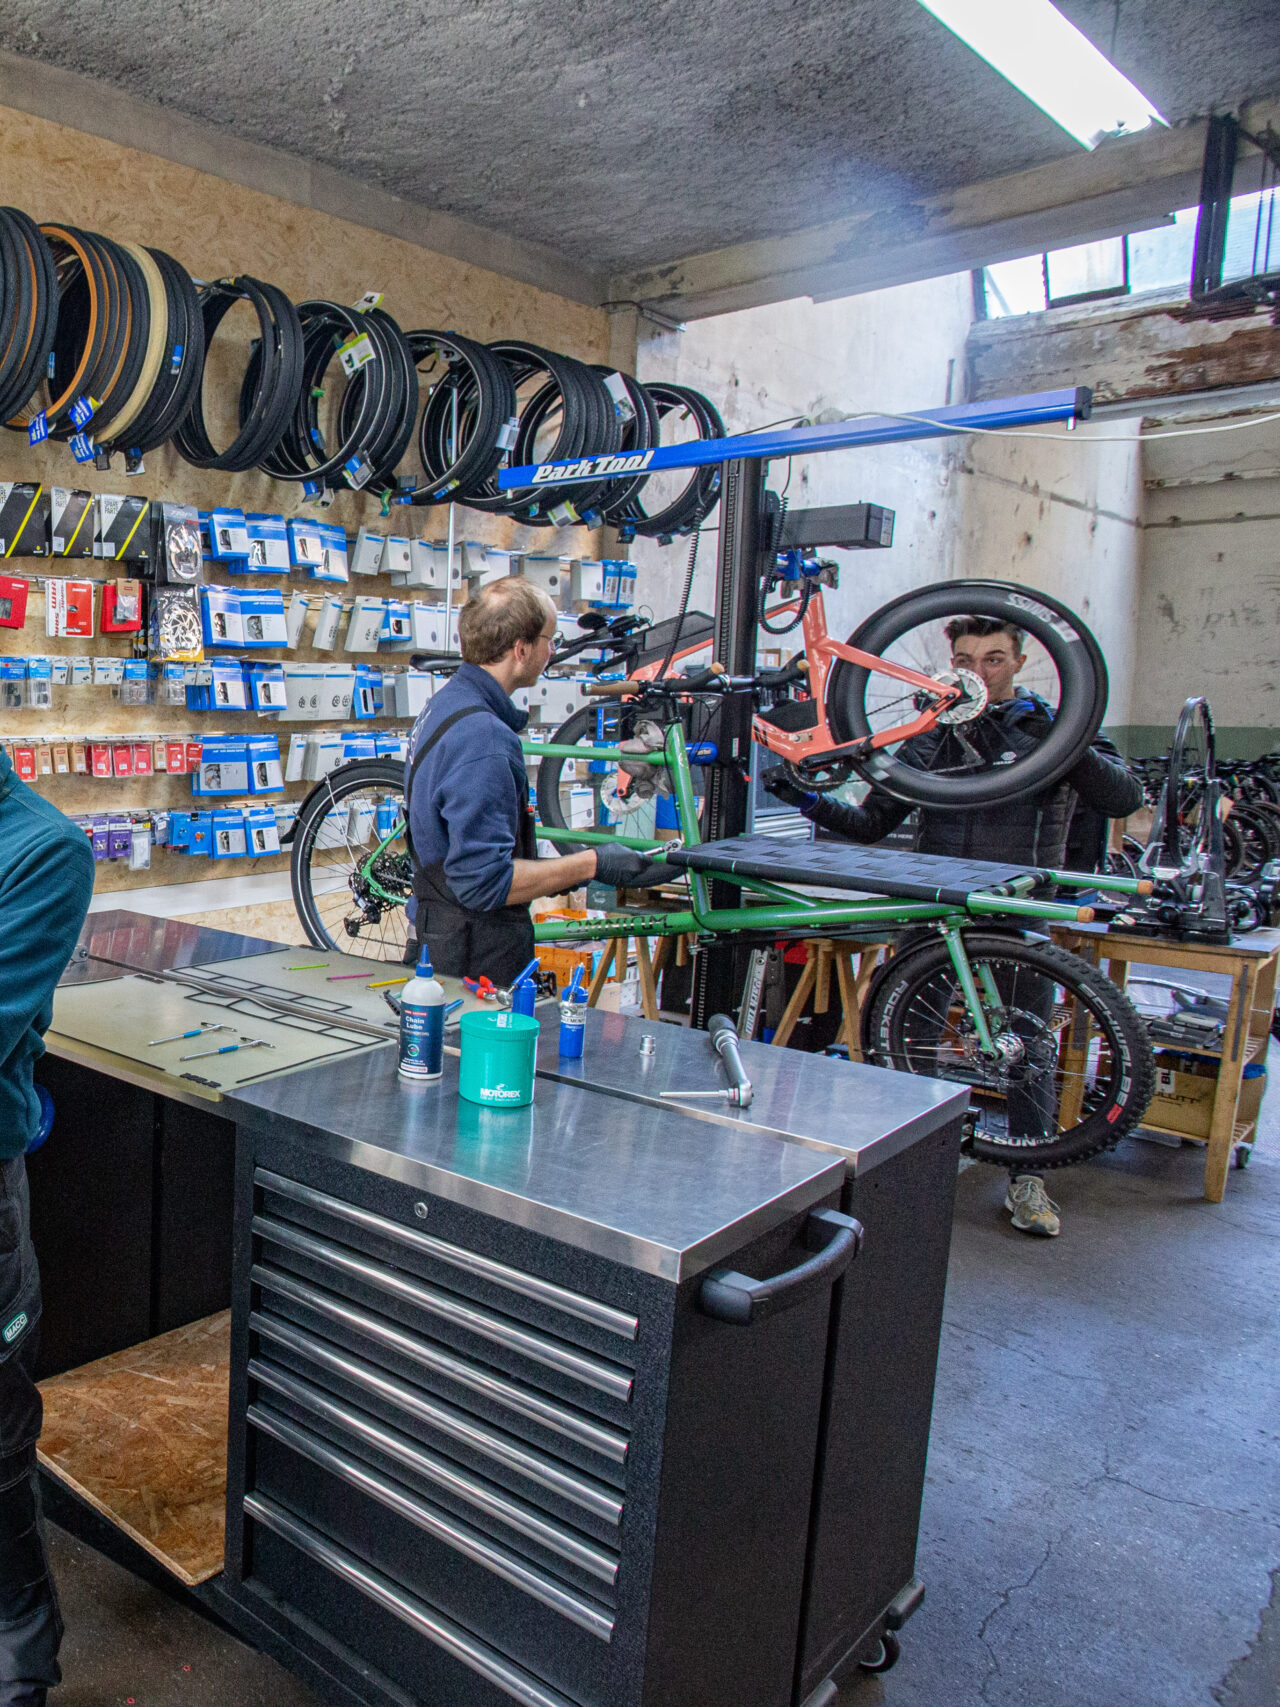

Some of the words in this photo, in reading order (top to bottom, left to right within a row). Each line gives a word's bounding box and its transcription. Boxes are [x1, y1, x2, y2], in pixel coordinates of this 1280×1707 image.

[532, 459, 594, 483] Park
[594, 450, 655, 476] Tool
[406, 1016, 424, 1024] Chain
[406, 1022, 423, 1030] Lube
[481, 1088, 520, 1098] MOTOREX
